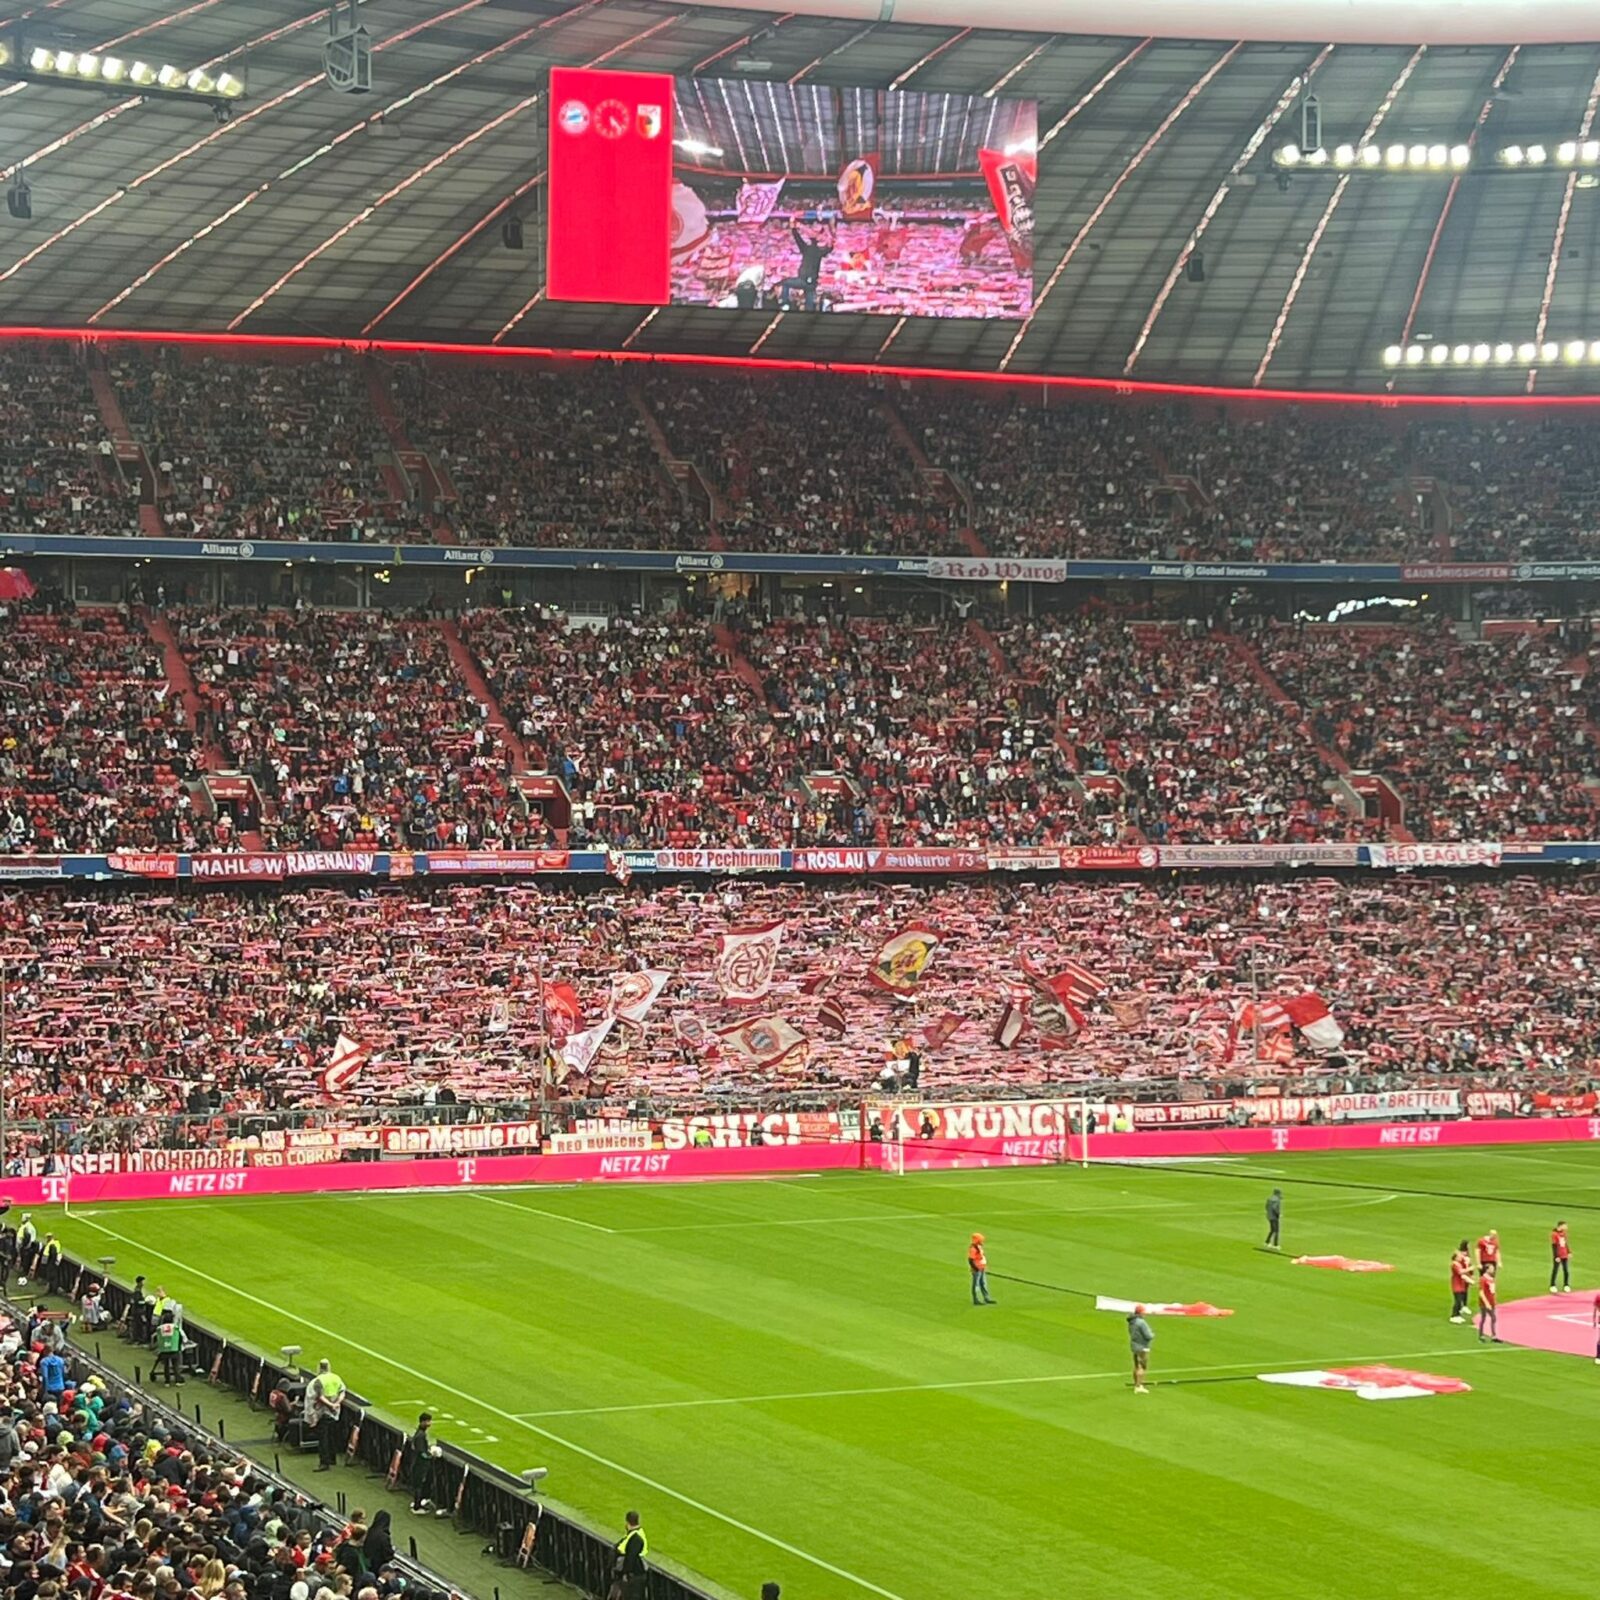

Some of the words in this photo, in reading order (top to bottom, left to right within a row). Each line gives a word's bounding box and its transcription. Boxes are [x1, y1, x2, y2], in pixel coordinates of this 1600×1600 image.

[201, 543, 238, 556] Allianz
[444, 550, 479, 562] Allianz
[676, 555, 709, 567] Allianz
[947, 562, 989, 578] Red
[1150, 565, 1181, 576] Allianz
[1195, 566, 1224, 576] Global
[1226, 567, 1267, 577] Investors
[1533, 566, 1565, 576] Global
[672, 851, 703, 868] 1982
[1386, 849, 1422, 863] RED
[1424, 848, 1485, 862] EAGLES
[1334, 1095, 1377, 1111] ADLER
[1387, 1092, 1450, 1108] BRETTEN
[1135, 1106, 1166, 1122] RED
[507, 1124, 539, 1146] rot
[1380, 1128, 1417, 1143] NETZ
[1418, 1126, 1441, 1142] IST
[557, 1140, 582, 1152] RED
[1003, 1140, 1039, 1156] NETZ
[1043, 1138, 1066, 1155] IST
[143, 1151, 243, 1173] ROHRDORF
[253, 1151, 283, 1167] RED
[287, 1149, 342, 1166] COBRAS
[600, 1156, 640, 1173] NETZ
[644, 1154, 671, 1171] IST
[169, 1174, 215, 1193] NETZ
[218, 1172, 246, 1190] IST
